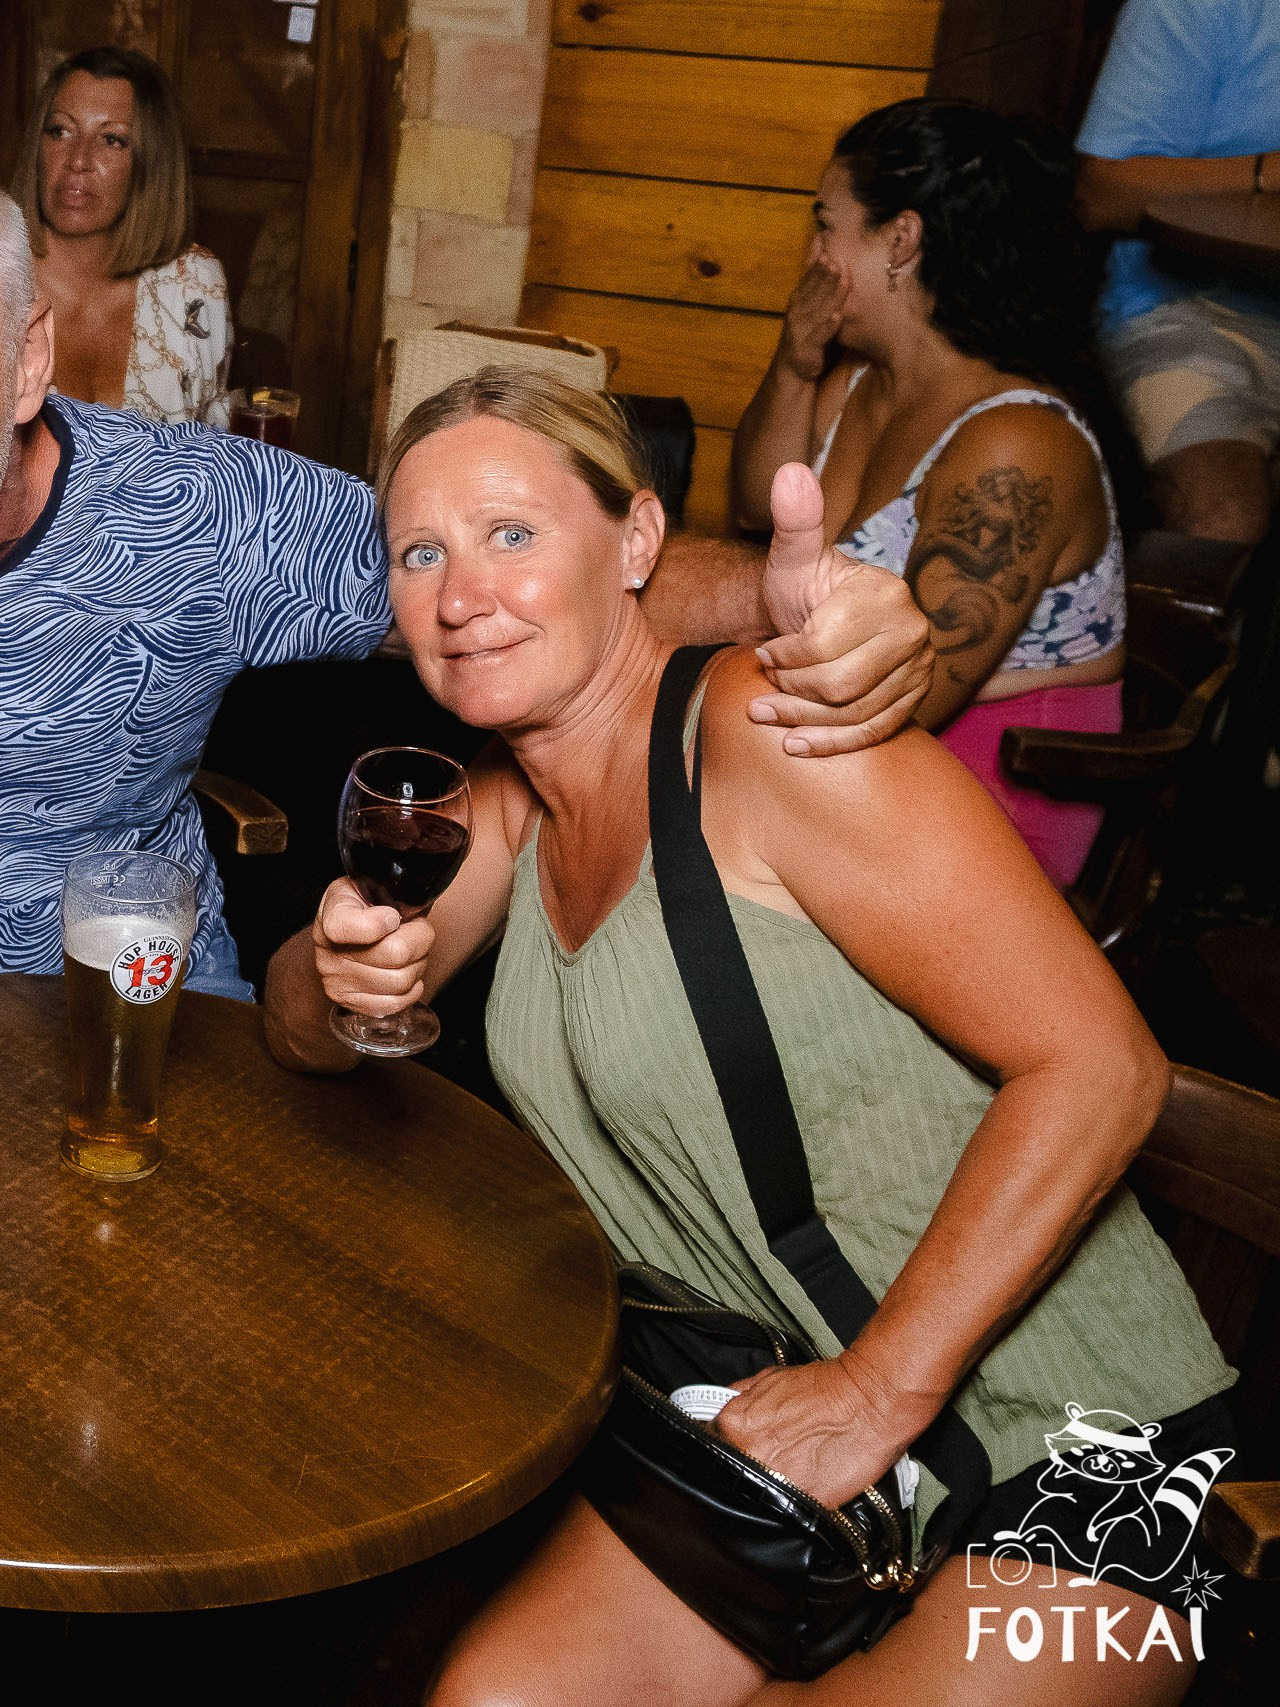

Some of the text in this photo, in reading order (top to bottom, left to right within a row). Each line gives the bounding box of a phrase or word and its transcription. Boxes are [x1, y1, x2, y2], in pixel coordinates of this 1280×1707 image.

[118, 940, 179, 969] HOP HOUSE
[127, 953, 174, 988] 13
[125, 982, 167, 999] LAGER
